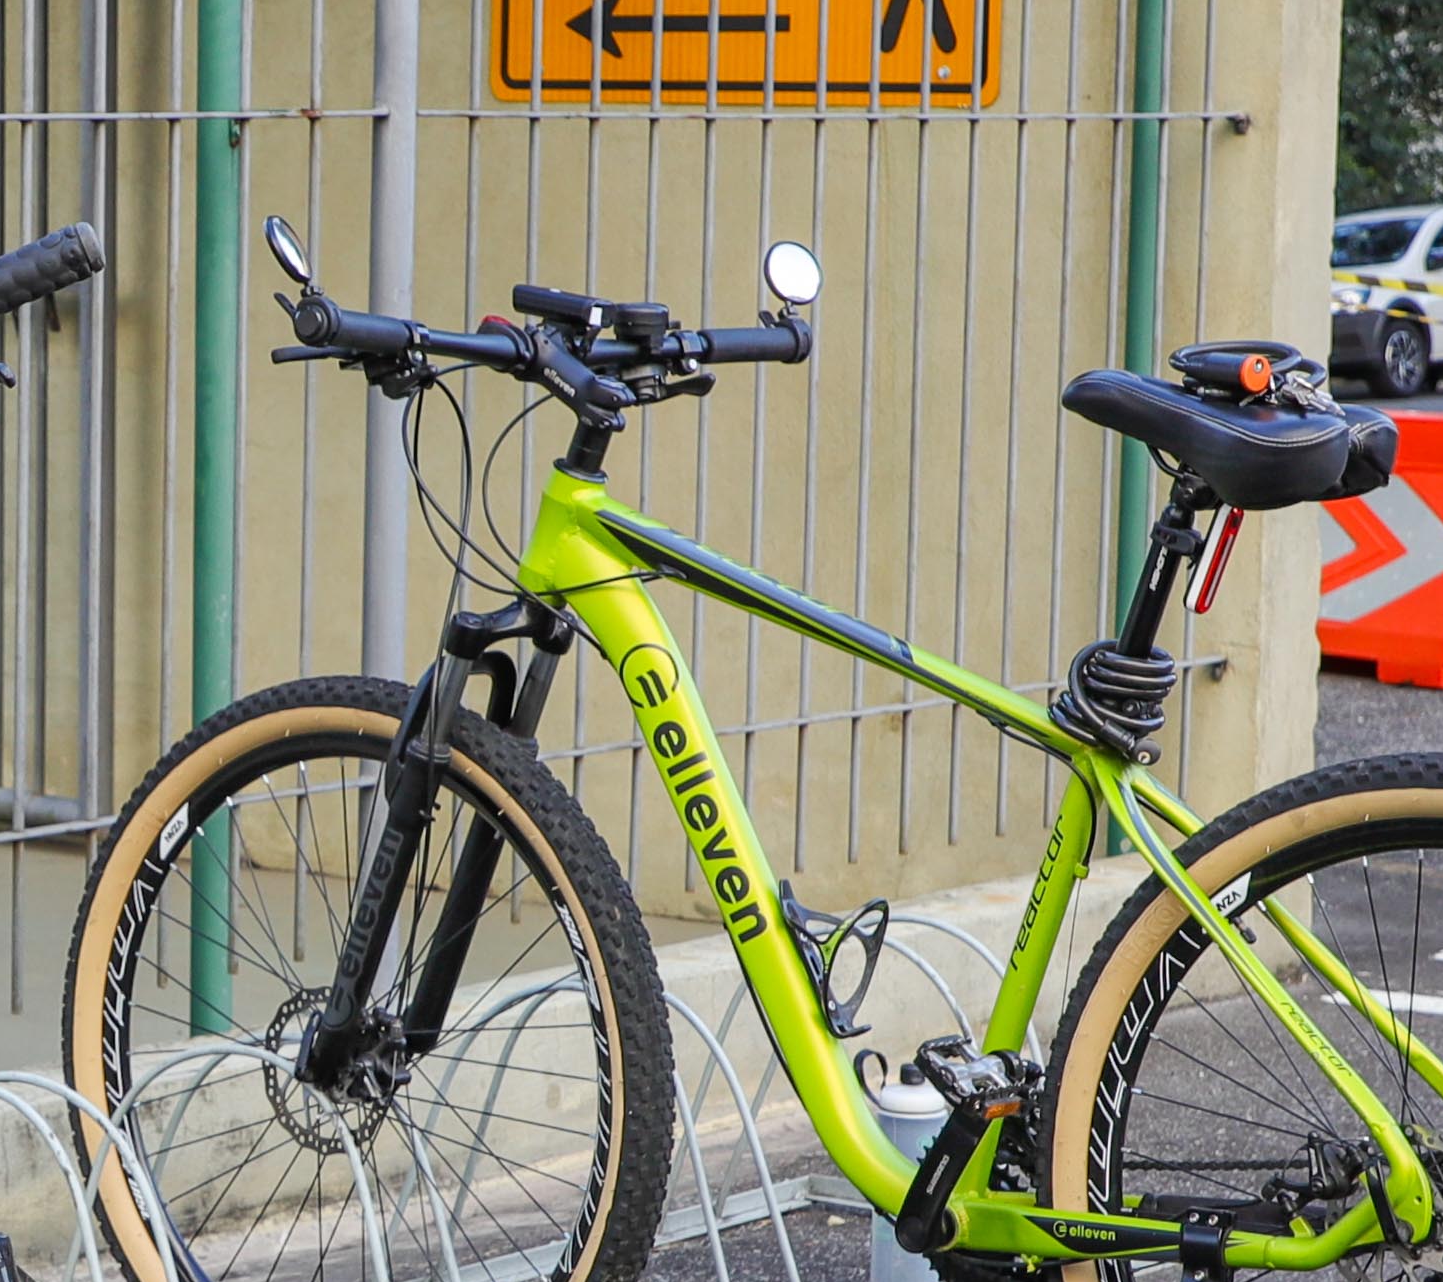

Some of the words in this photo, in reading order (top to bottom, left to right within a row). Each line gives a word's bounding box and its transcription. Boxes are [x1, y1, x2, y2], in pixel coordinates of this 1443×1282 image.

[341, 827, 404, 979] elleven
[653, 721, 769, 945] elleven
[1010, 814, 1064, 972] reactor
